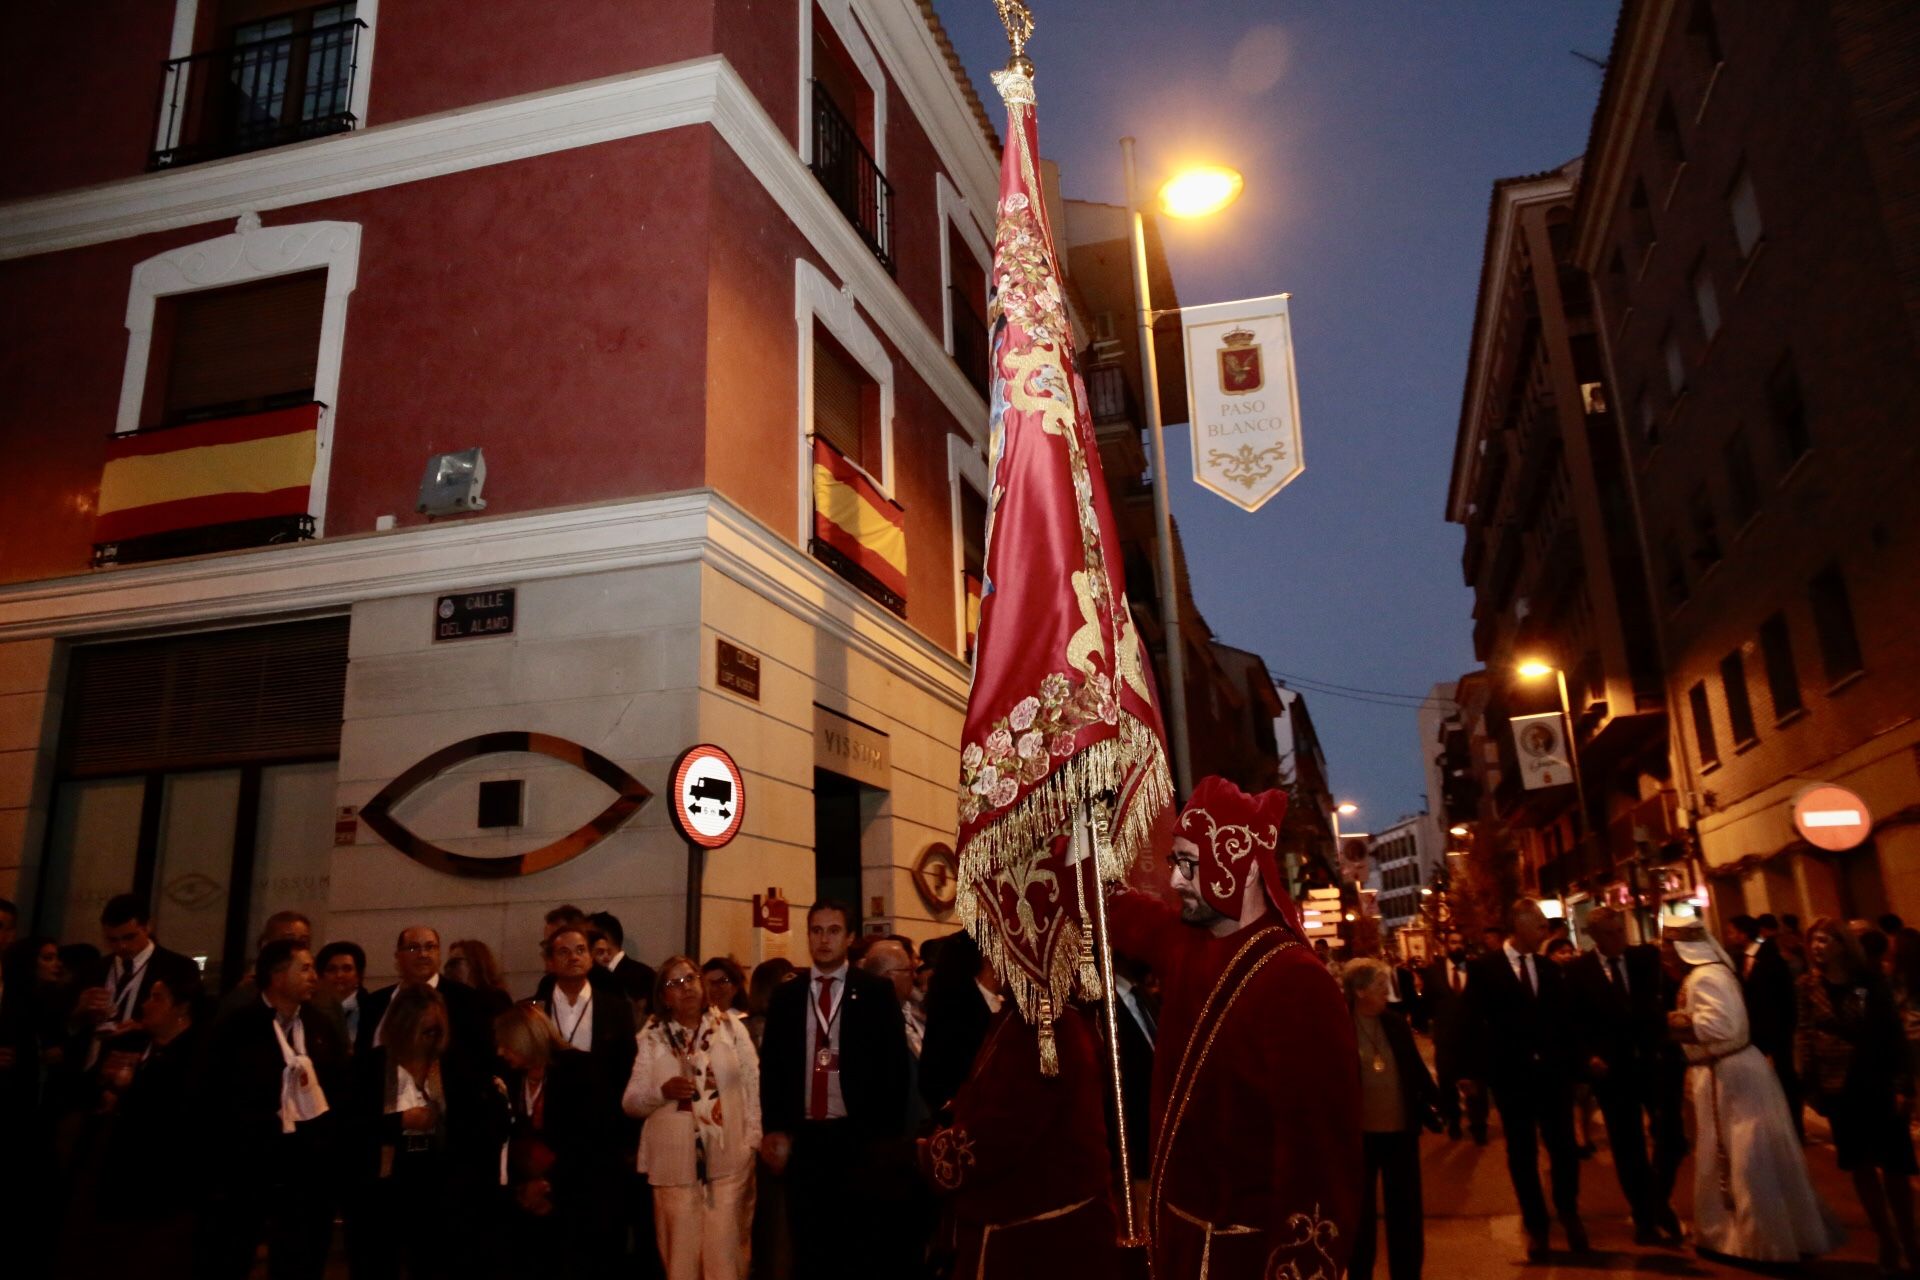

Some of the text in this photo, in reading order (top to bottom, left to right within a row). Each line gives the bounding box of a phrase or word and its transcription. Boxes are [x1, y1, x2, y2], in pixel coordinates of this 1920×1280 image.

[1221, 400, 1265, 416] PASO
[1208, 417, 1282, 437] BLANCO
[465, 593, 504, 610] CALLE
[441, 622, 463, 636] DEL
[825, 729, 882, 770] VISSUM
